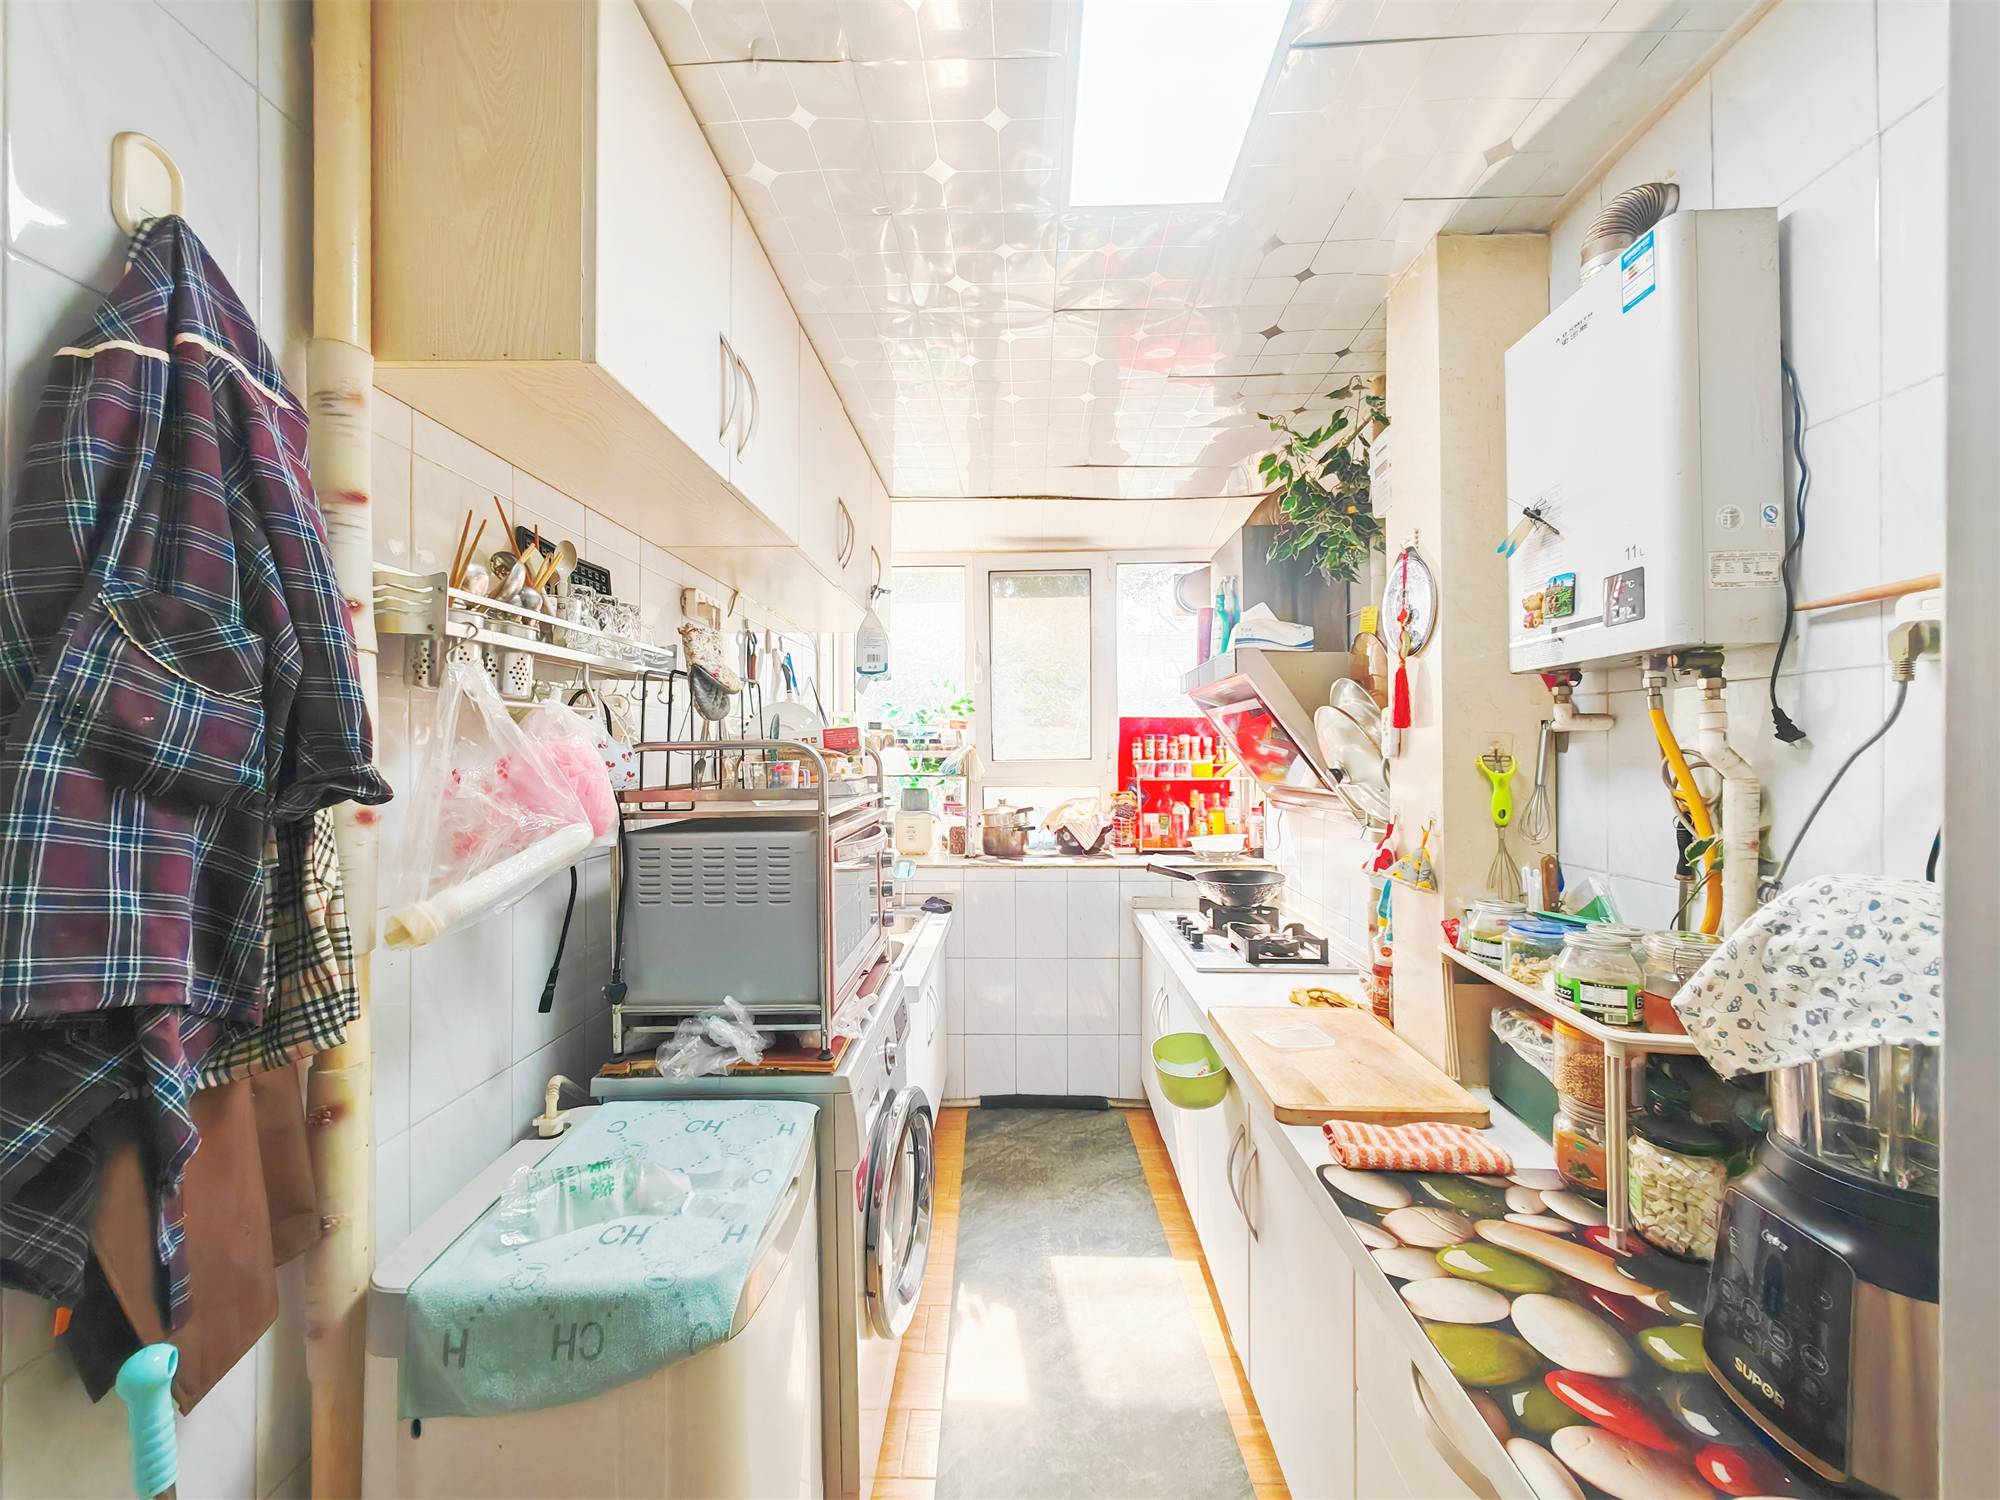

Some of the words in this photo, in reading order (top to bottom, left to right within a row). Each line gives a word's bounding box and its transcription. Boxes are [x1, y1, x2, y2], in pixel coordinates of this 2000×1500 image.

[684, 1119, 725, 1134] CH
[776, 1122, 797, 1136] H
[751, 1168, 773, 1184] C
[598, 1224, 652, 1246] CH
[720, 1224, 749, 1244] H
[442, 1328, 469, 1368] H
[1734, 1356, 1785, 1410] SUPOR
